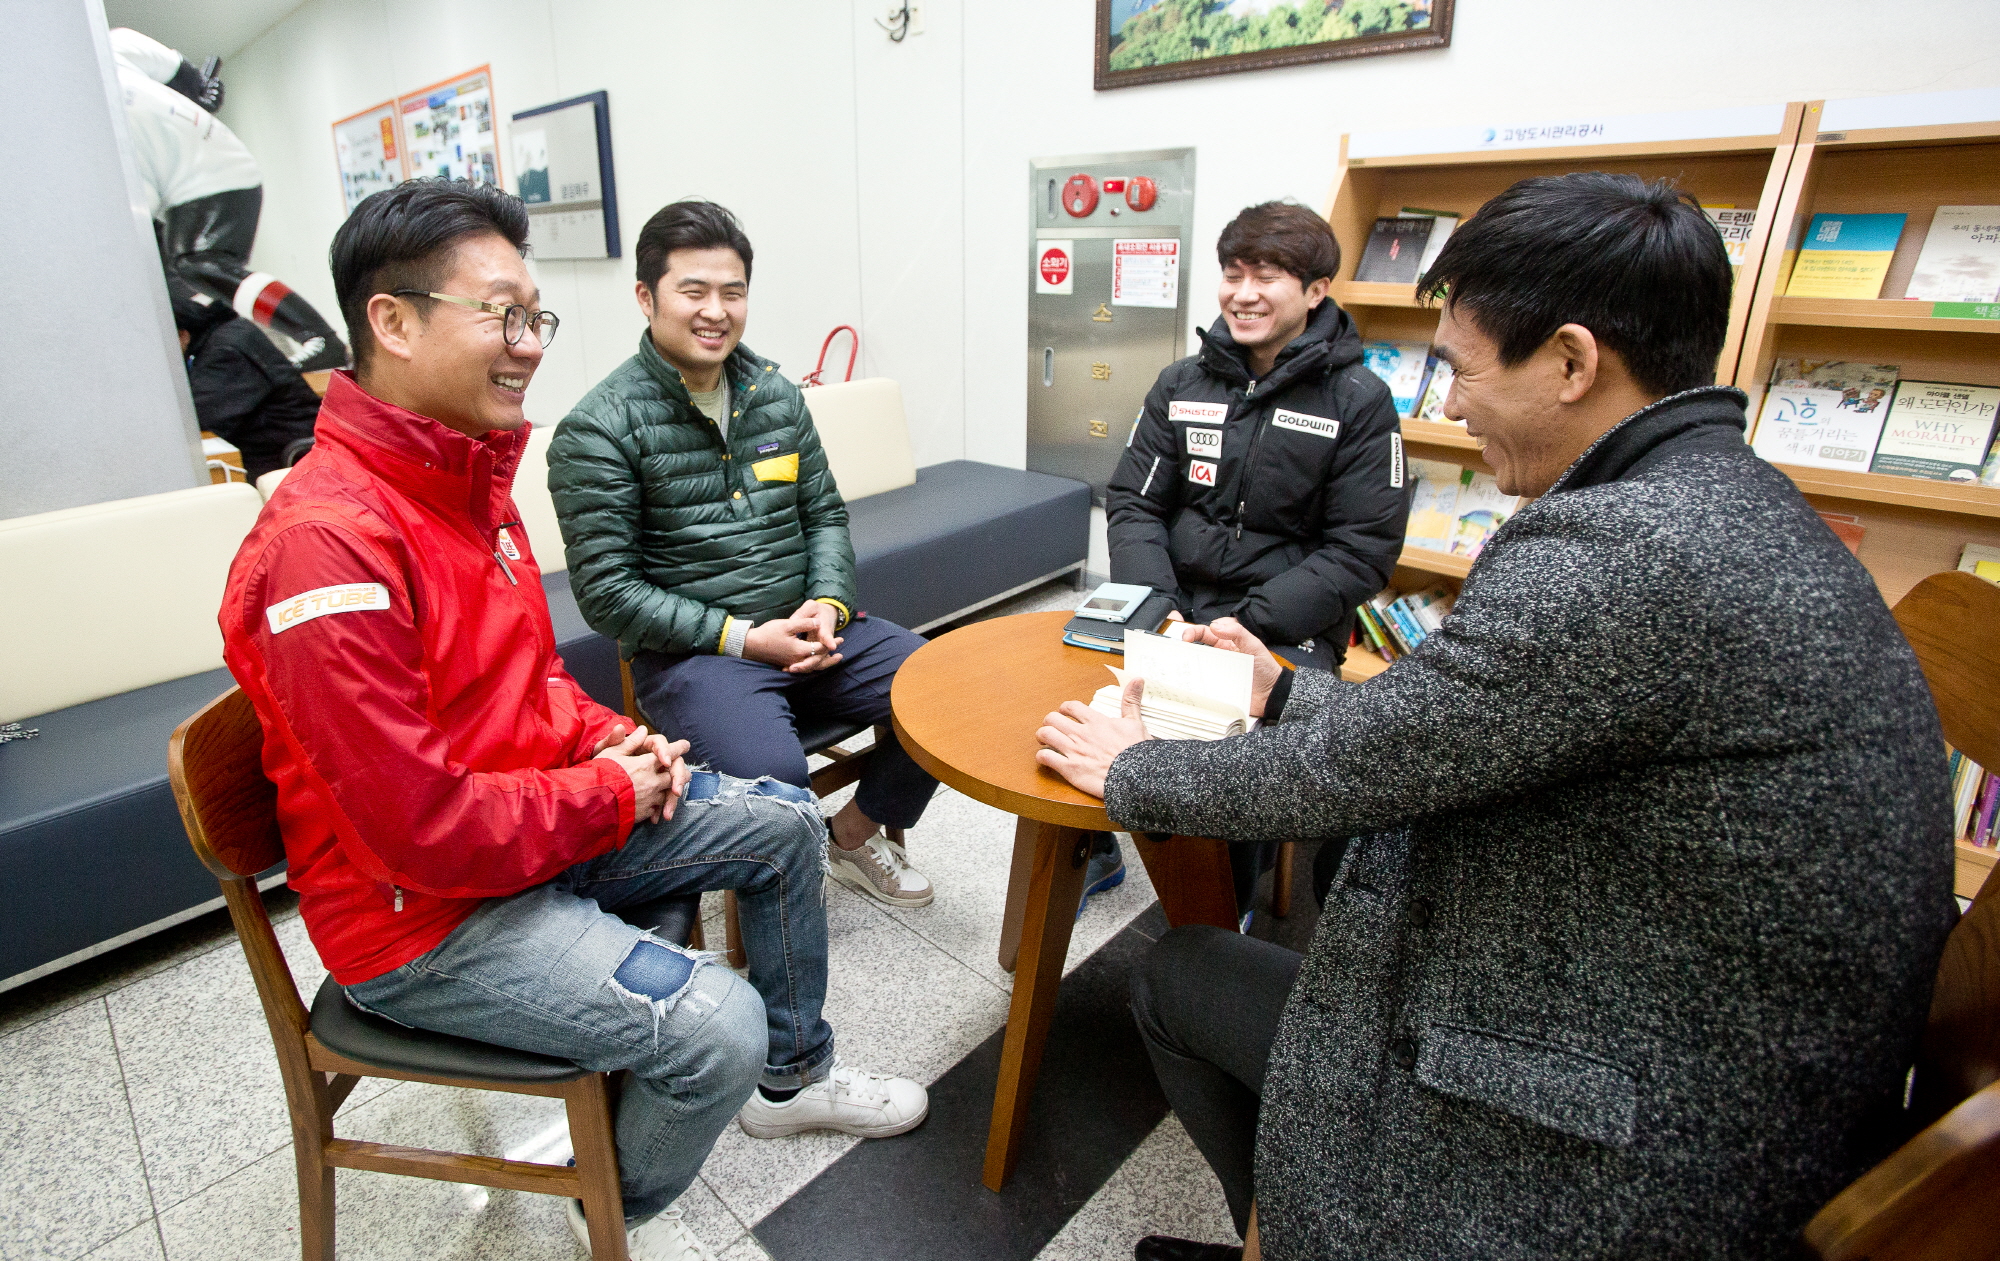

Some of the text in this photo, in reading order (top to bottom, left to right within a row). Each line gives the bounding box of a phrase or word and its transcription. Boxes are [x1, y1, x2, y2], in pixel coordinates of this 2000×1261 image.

[1503, 123, 1604, 142] 고양도시관리공사
[1971, 233, 2000, 243] 아파
[1042, 257, 1068, 268] 소화기
[1896, 396, 1995, 417] 왜 도덕인가?
[1778, 427, 1858, 442] 꿈틀거리는
[1915, 420, 1964, 434] WHY
[1891, 429, 1981, 446] MORALITY
[1785, 443, 1866, 461] 색채 이야기
[1191, 463, 1213, 483] ICA
[277, 591, 378, 626] ICE TUBE
